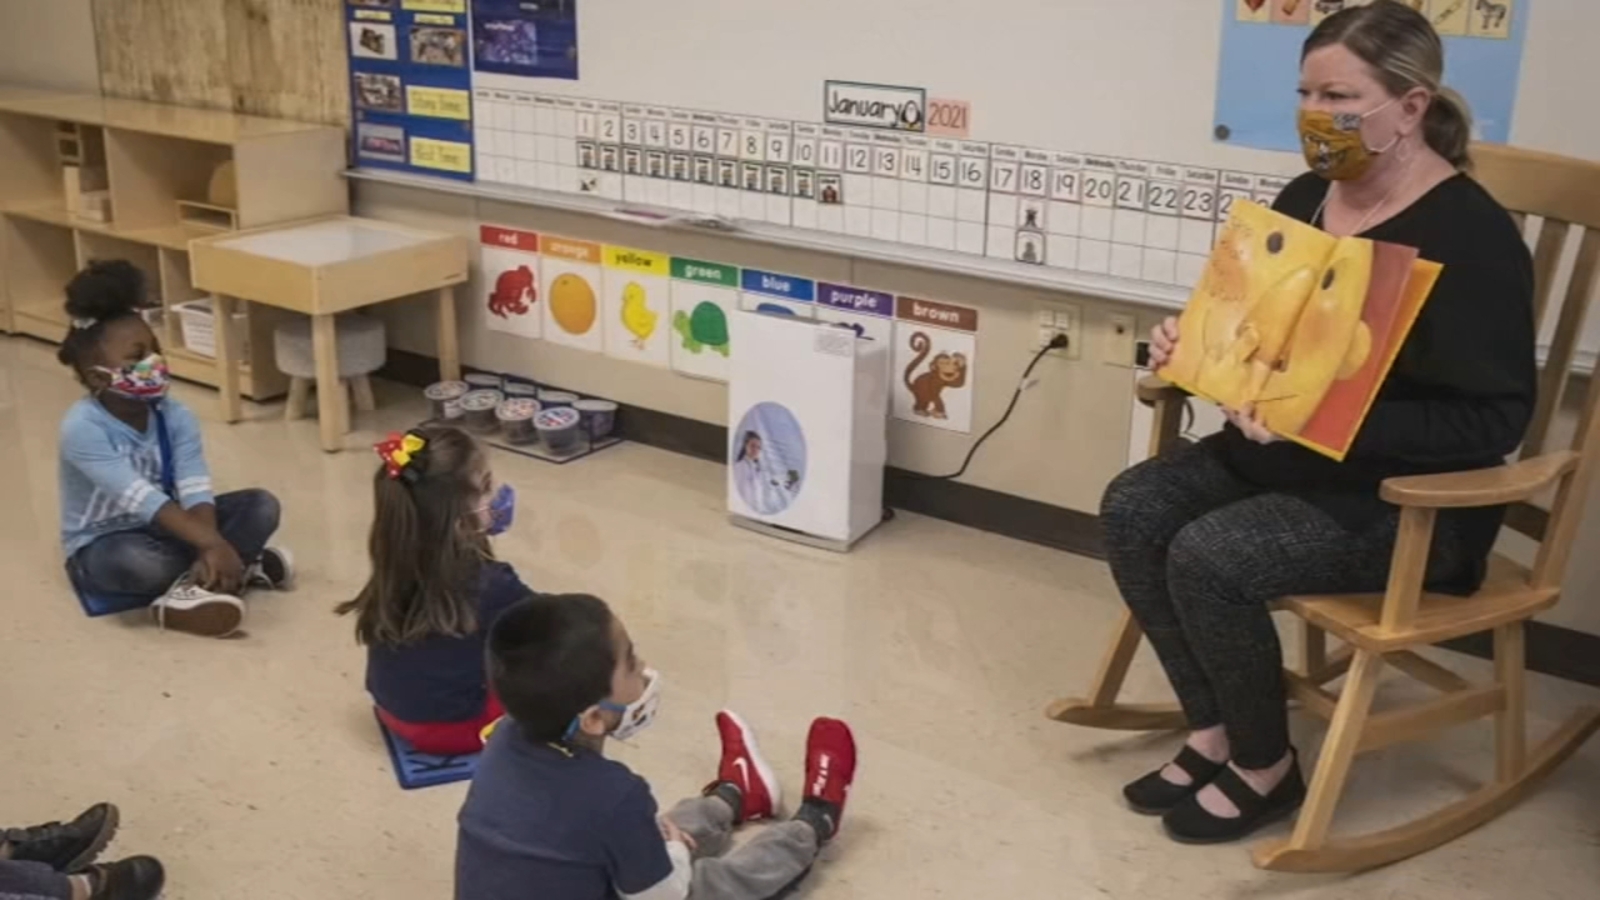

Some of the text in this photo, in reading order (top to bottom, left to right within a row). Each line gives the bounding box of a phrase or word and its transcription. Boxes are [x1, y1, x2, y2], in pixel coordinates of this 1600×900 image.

[828, 90, 901, 127] January
[928, 102, 966, 129] 2021
[583, 117, 588, 134] 1
[603, 120, 614, 137] 2
[627, 123, 637, 140] 3
[673, 129, 684, 146] 5
[698, 130, 710, 148] 6
[722, 132, 732, 149] 7
[746, 135, 757, 154] 8
[771, 140, 782, 158] 9
[795, 144, 811, 161] 10
[824, 146, 838, 164] 11
[850, 148, 866, 168] 12
[878, 151, 895, 171] 13
[933, 160, 951, 180] 15
[962, 161, 981, 182] 16
[994, 167, 1013, 187] 17
[1024, 169, 1041, 190] 18
[1056, 174, 1075, 195] 19
[1085, 178, 1111, 199] 20
[1119, 181, 1143, 202] 21
[1150, 186, 1177, 209] 22
[1184, 190, 1214, 212] 23
[498, 233, 517, 245] red
[551, 243, 588, 258] orange
[615, 252, 652, 268] yellow
[685, 263, 722, 280] green
[762, 274, 790, 292] blue
[831, 289, 877, 308] purple
[913, 302, 959, 322] brown
